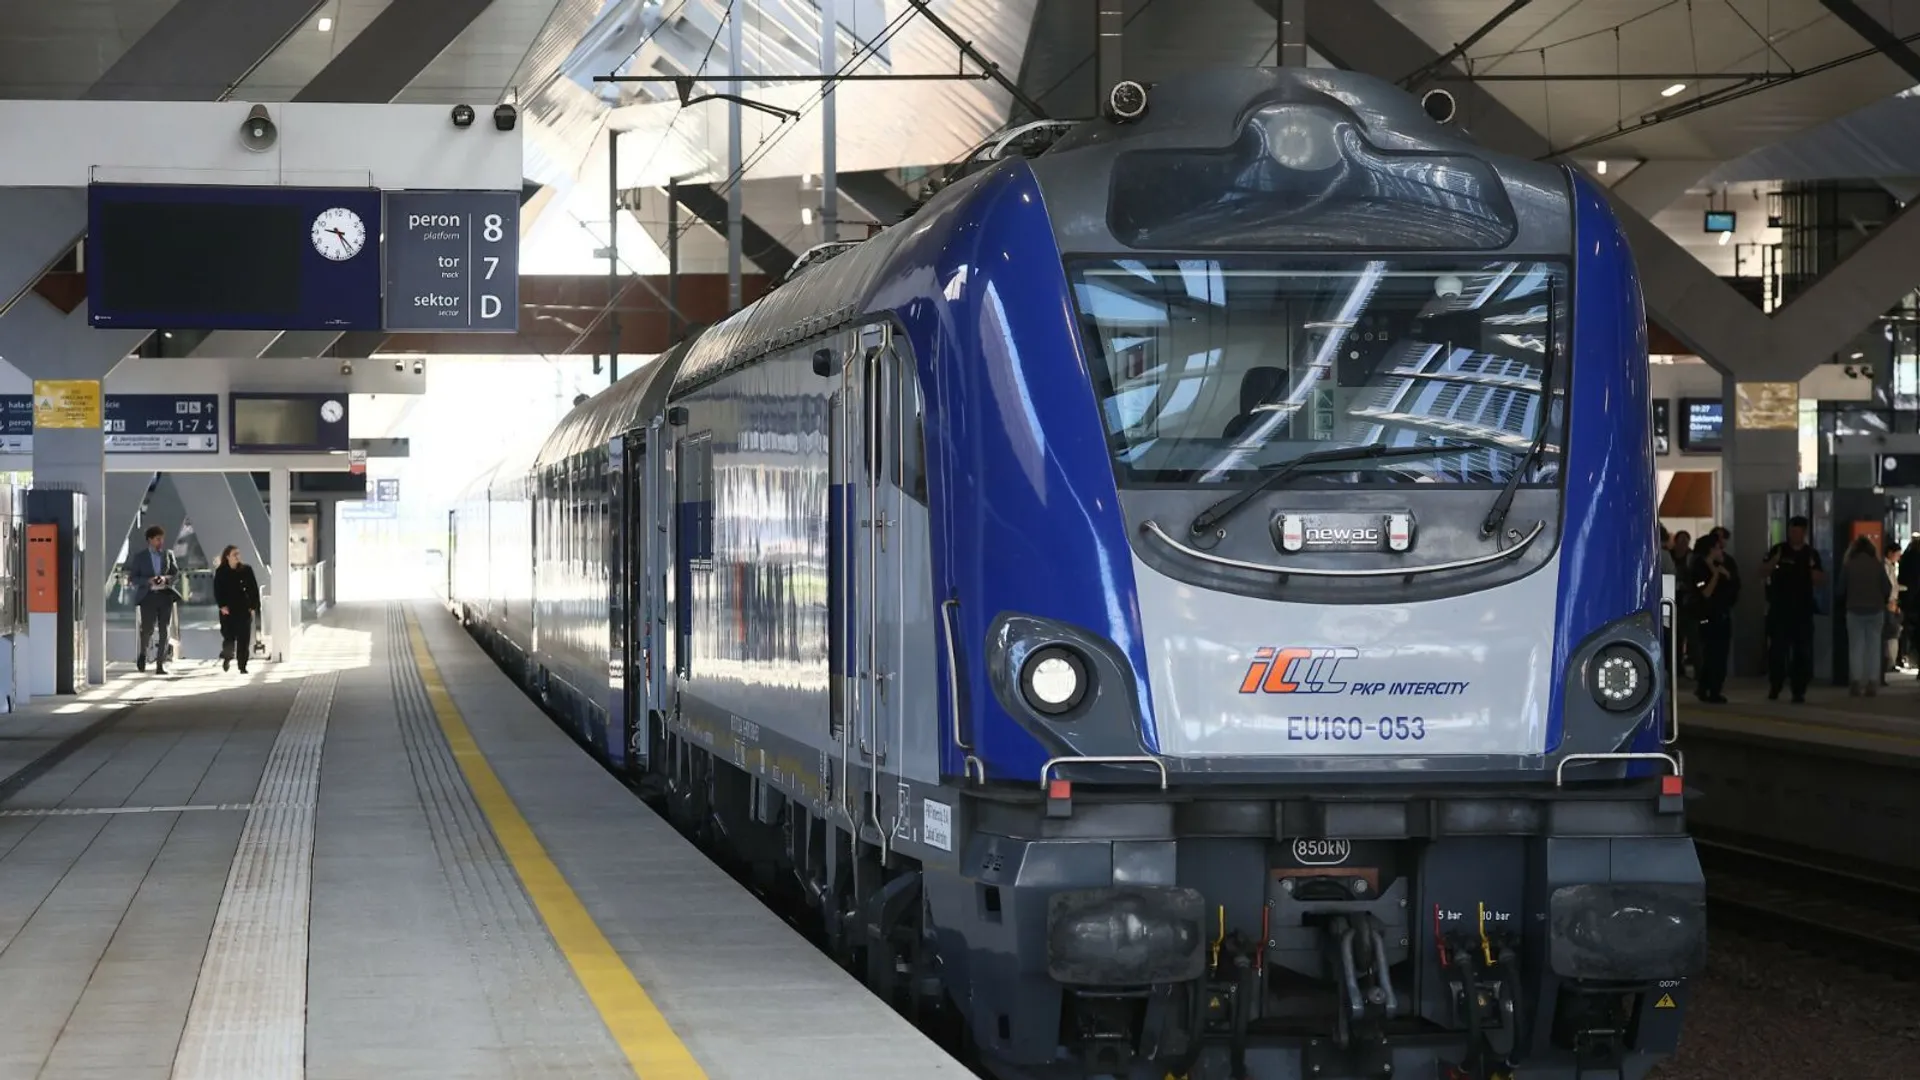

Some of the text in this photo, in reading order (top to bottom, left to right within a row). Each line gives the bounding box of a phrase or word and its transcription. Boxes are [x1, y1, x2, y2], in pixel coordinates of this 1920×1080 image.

[409, 214, 460, 230] peron
[483, 214, 503, 242] 8
[424, 231, 460, 241] platform
[438, 256, 460, 268] tor
[483, 257, 499, 280] 7
[414, 293, 460, 307] sektor
[481, 295, 502, 319] D
[178, 420, 200, 432] 1-7
[1350, 682, 1470, 695] PKP INTERCITY
[1288, 716, 1425, 740] EU160-053
[1298, 840, 1346, 856] 850kN
[1438, 910, 1462, 920] 5 bar
[1496, 911, 1510, 920] bar
